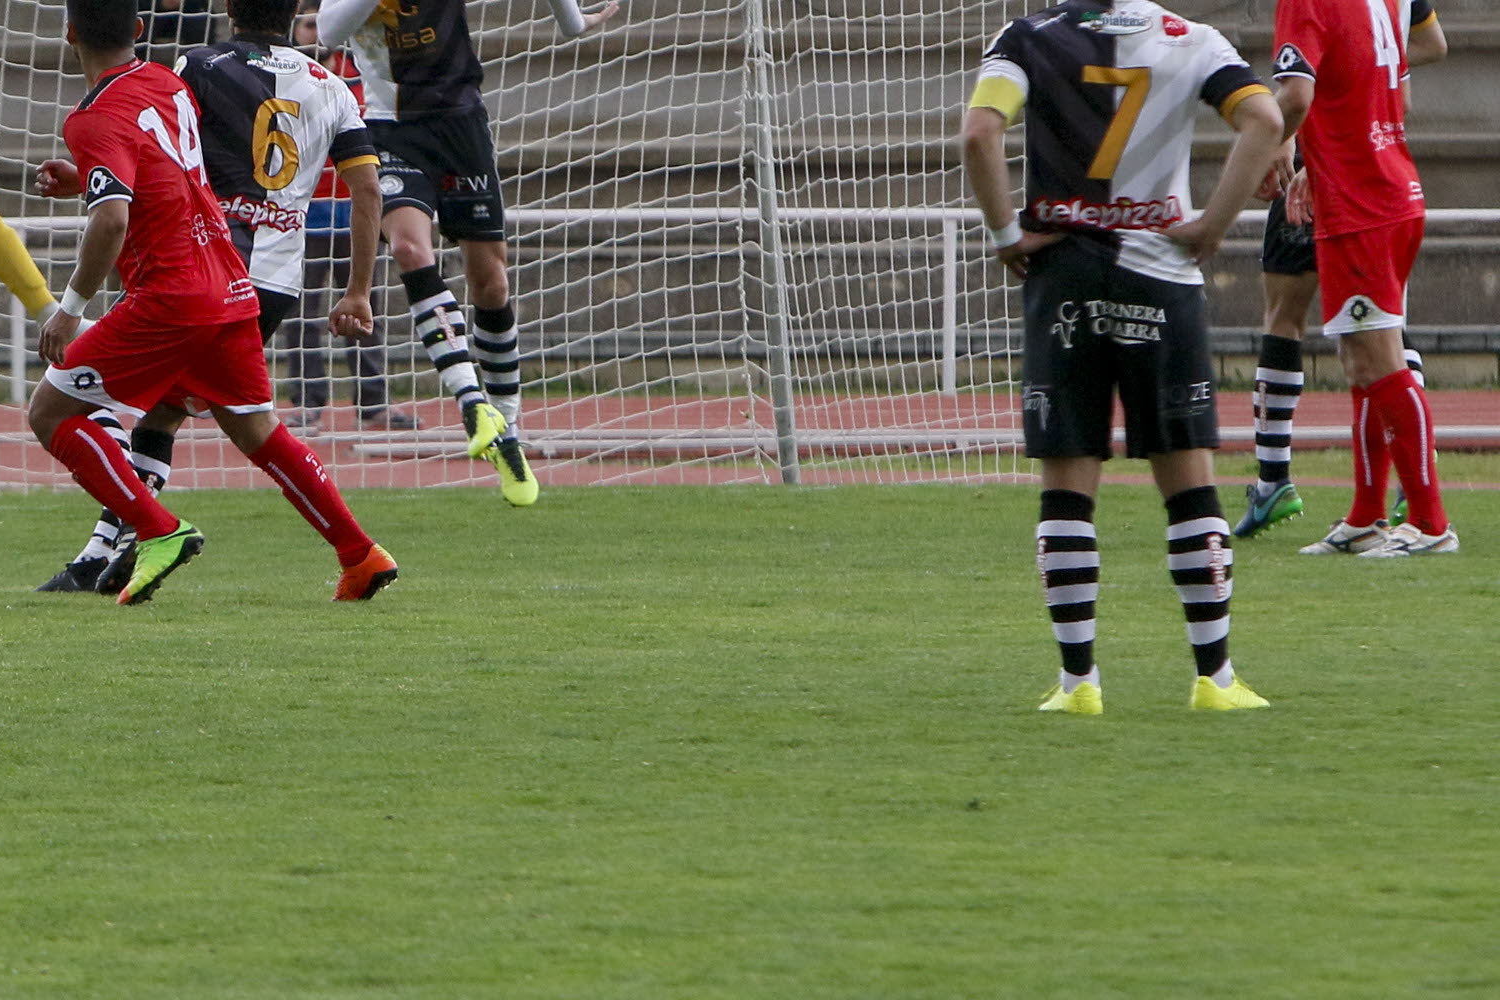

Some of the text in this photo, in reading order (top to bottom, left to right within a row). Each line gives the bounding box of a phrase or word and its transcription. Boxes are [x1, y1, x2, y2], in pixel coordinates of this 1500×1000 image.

[136, 89, 209, 187] 14
[253, 98, 300, 190] 6
[1082, 65, 1152, 180] 7
[218, 196, 307, 232] elepizza
[1035, 195, 1183, 230] telepizza
